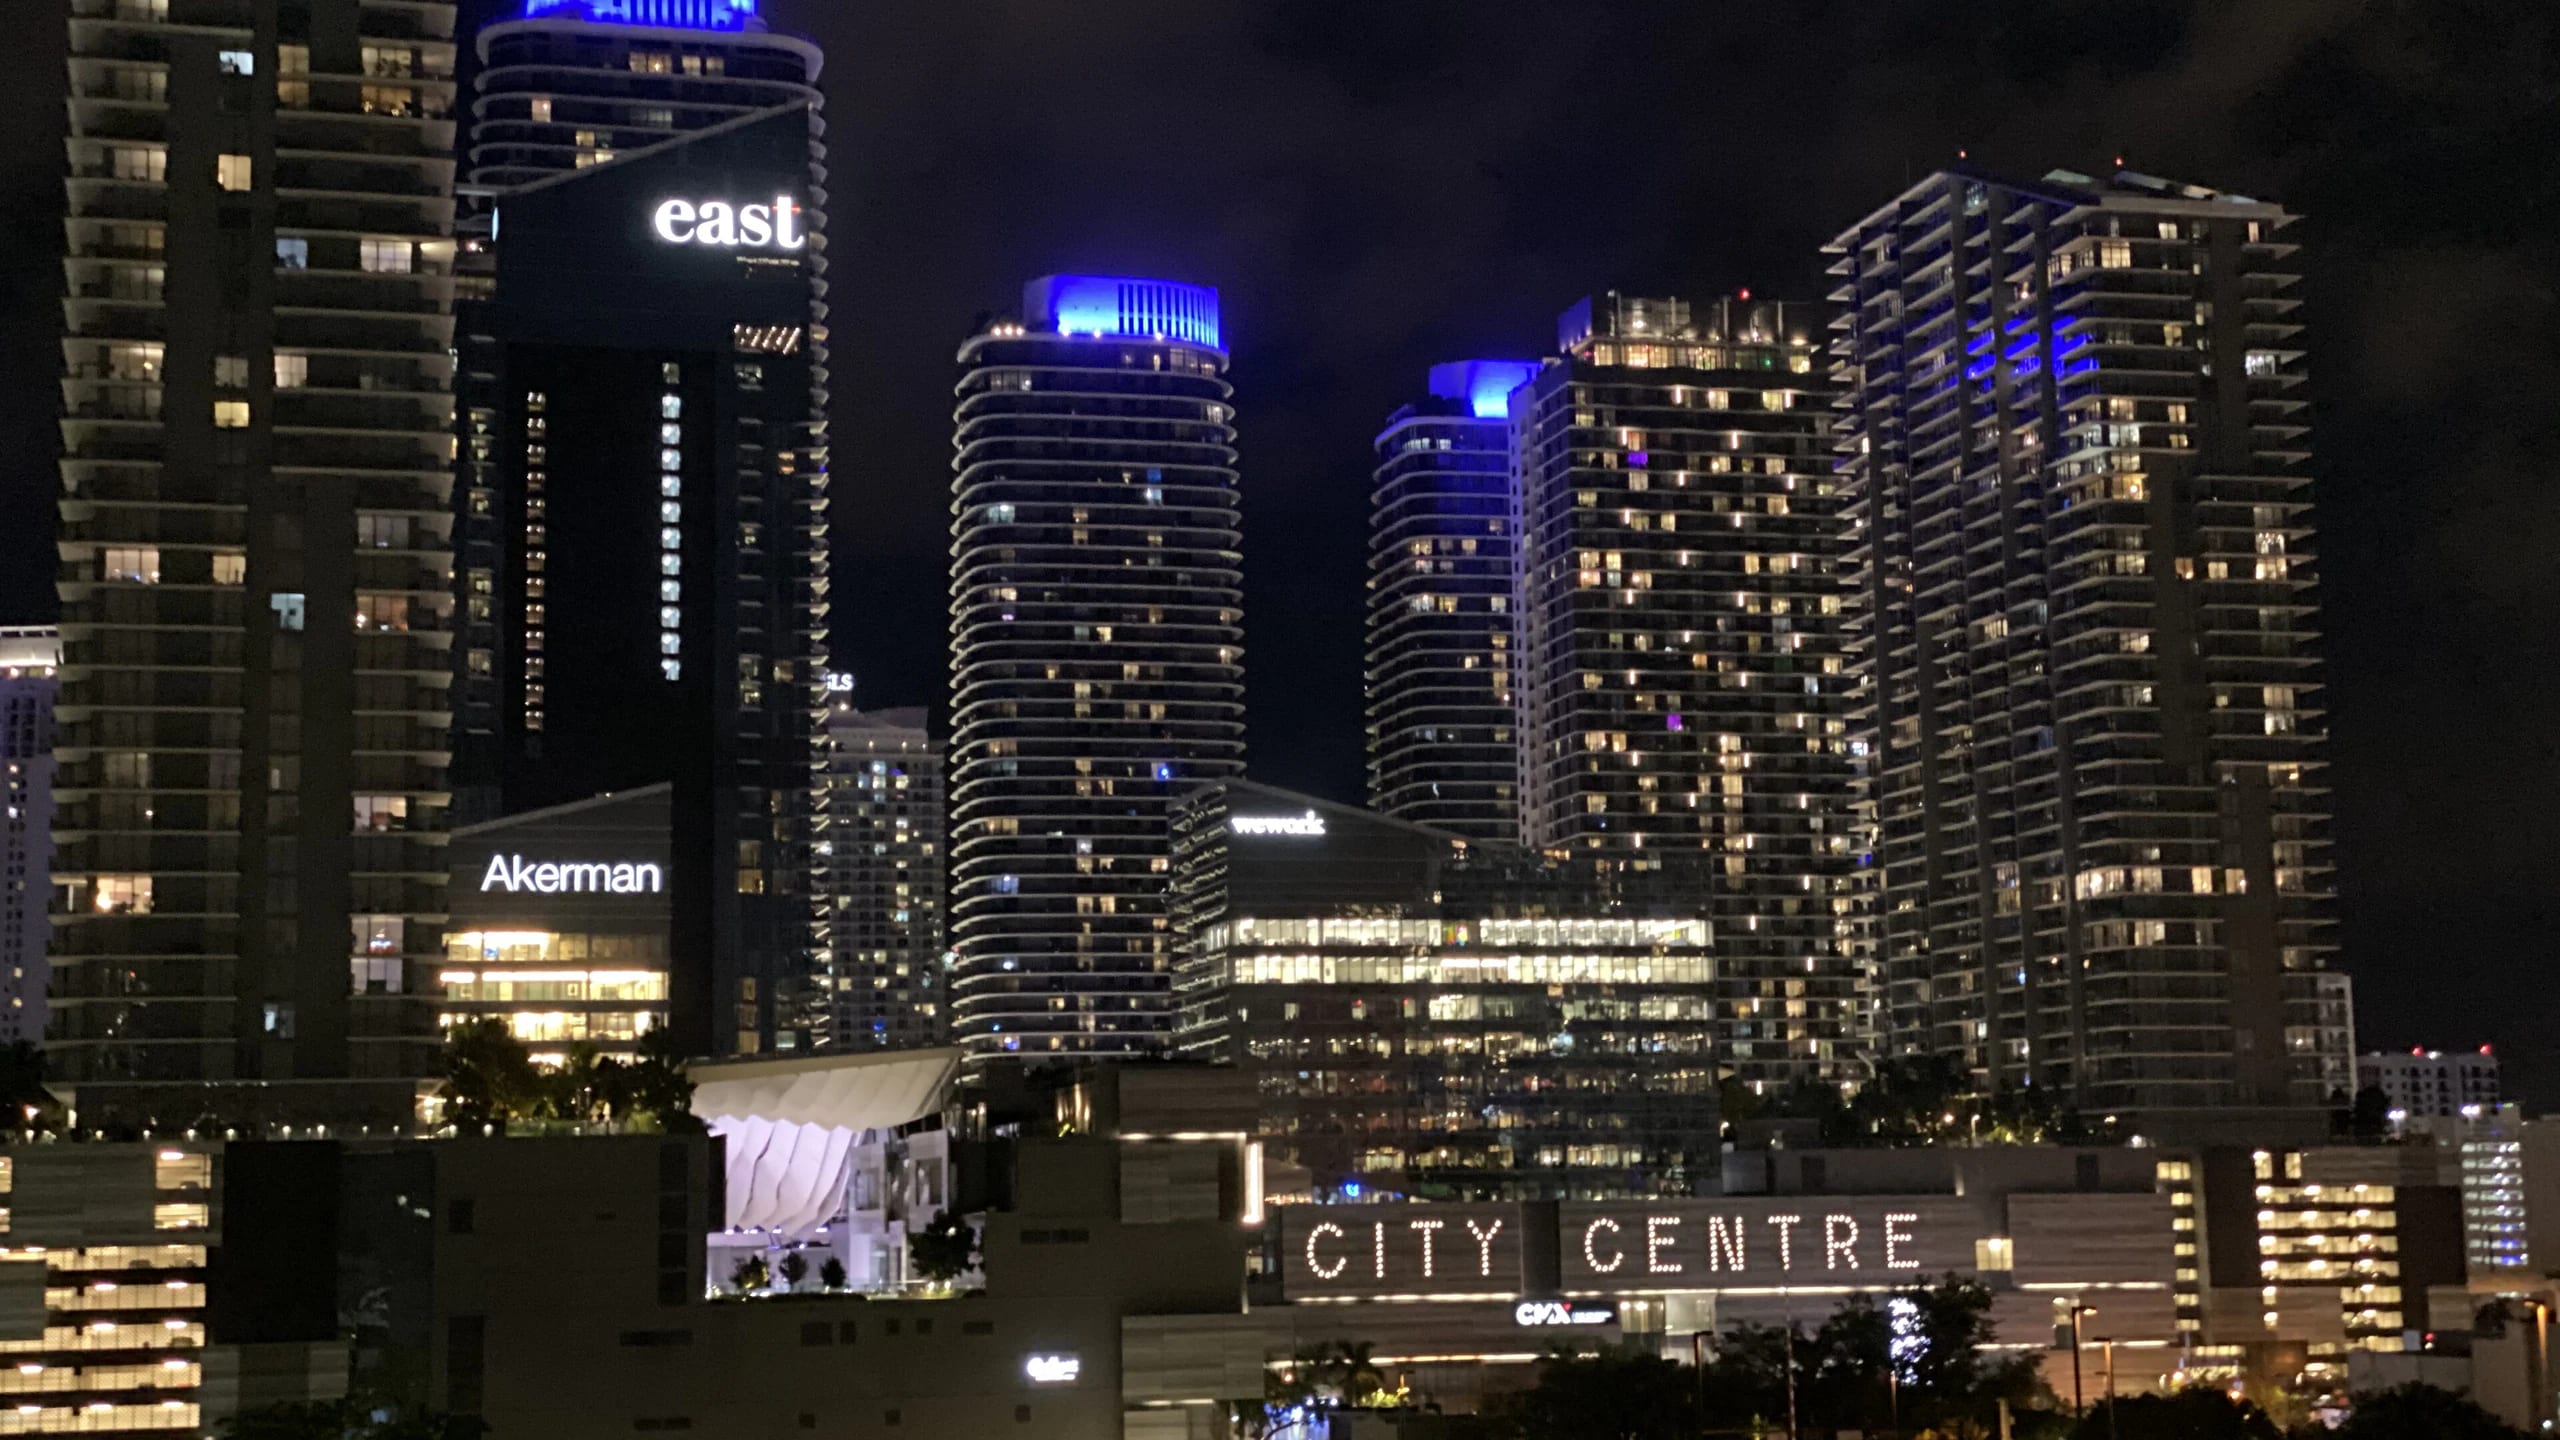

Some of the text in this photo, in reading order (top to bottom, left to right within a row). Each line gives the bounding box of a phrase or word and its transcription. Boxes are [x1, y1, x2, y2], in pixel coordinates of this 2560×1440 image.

[655, 195, 804, 249] east
[1231, 809, 1326, 834] wework
[480, 853, 661, 893] Akerman
[1305, 1212, 1922, 1280] CITY CENTRE
